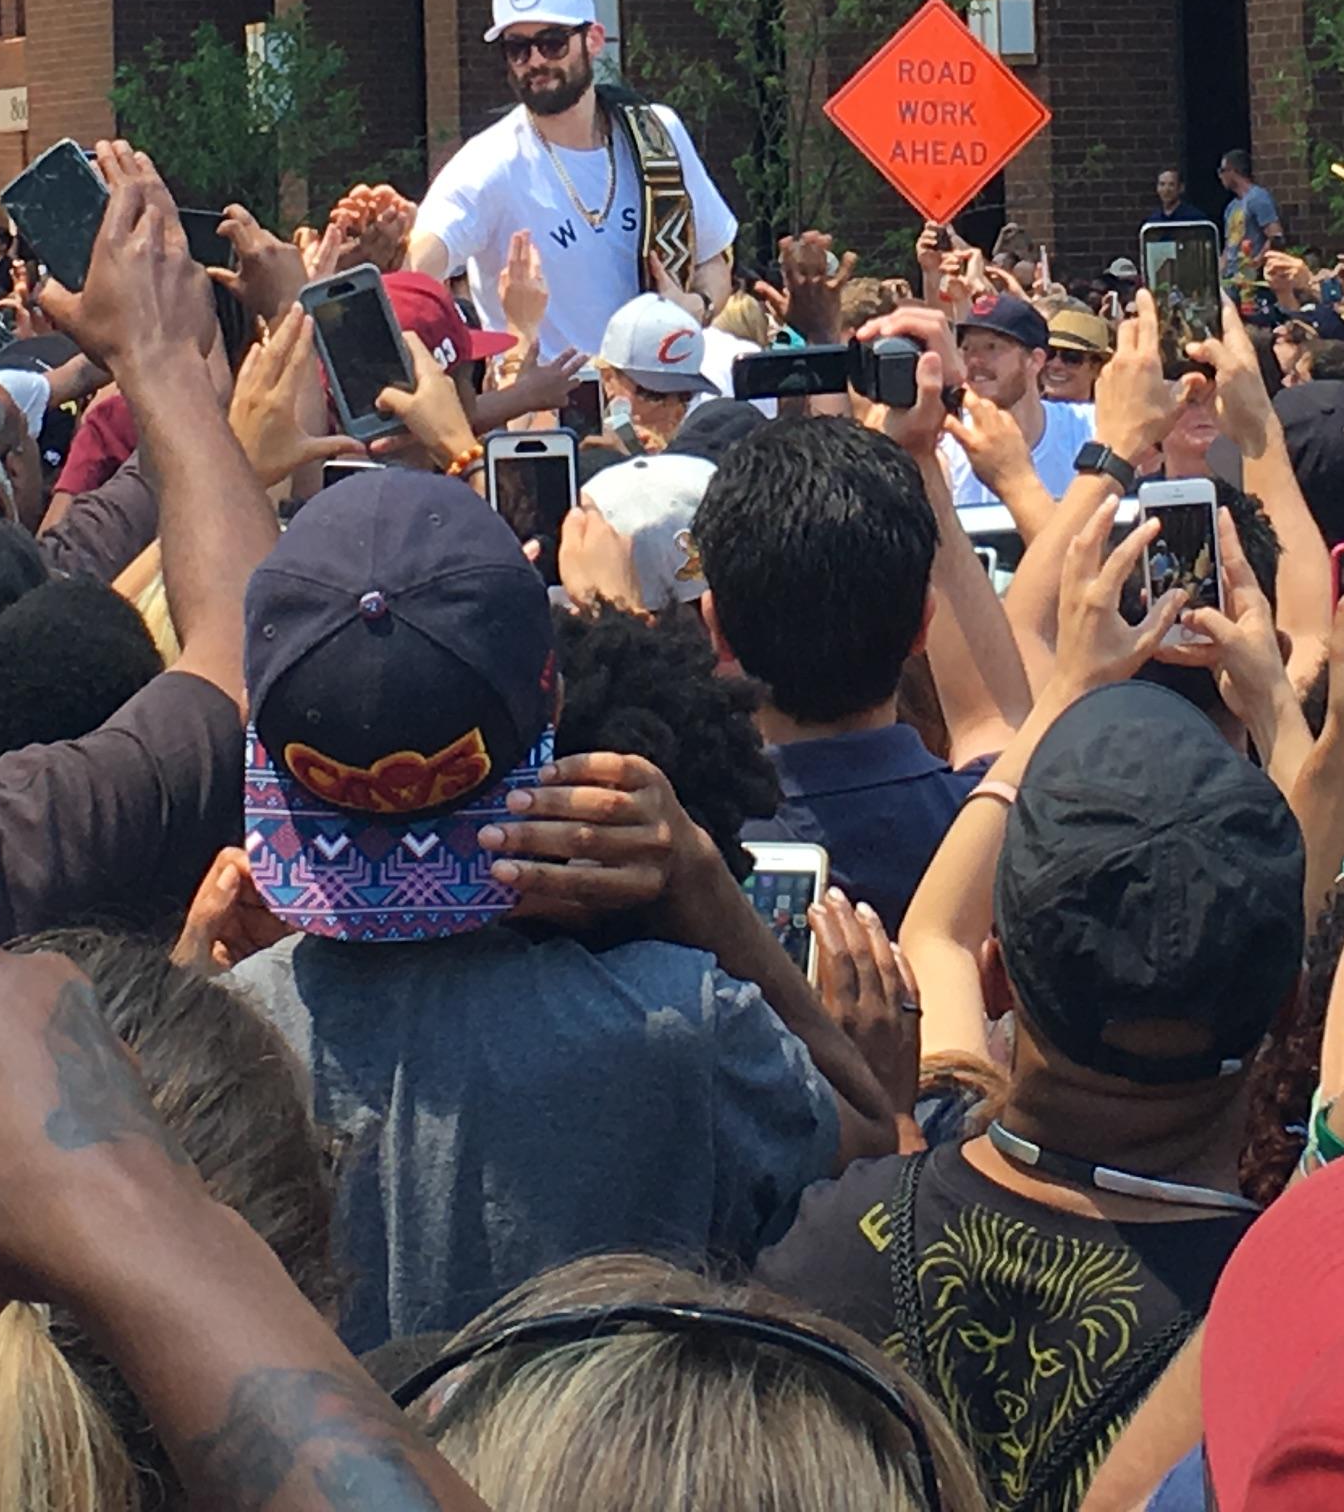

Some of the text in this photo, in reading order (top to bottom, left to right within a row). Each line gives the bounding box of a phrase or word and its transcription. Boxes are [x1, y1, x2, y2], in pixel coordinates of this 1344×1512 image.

[898, 59, 976, 85] ROAD
[898, 100, 976, 126] WORK
[890, 140, 988, 165] AHEAD
[657, 329, 695, 364] C
